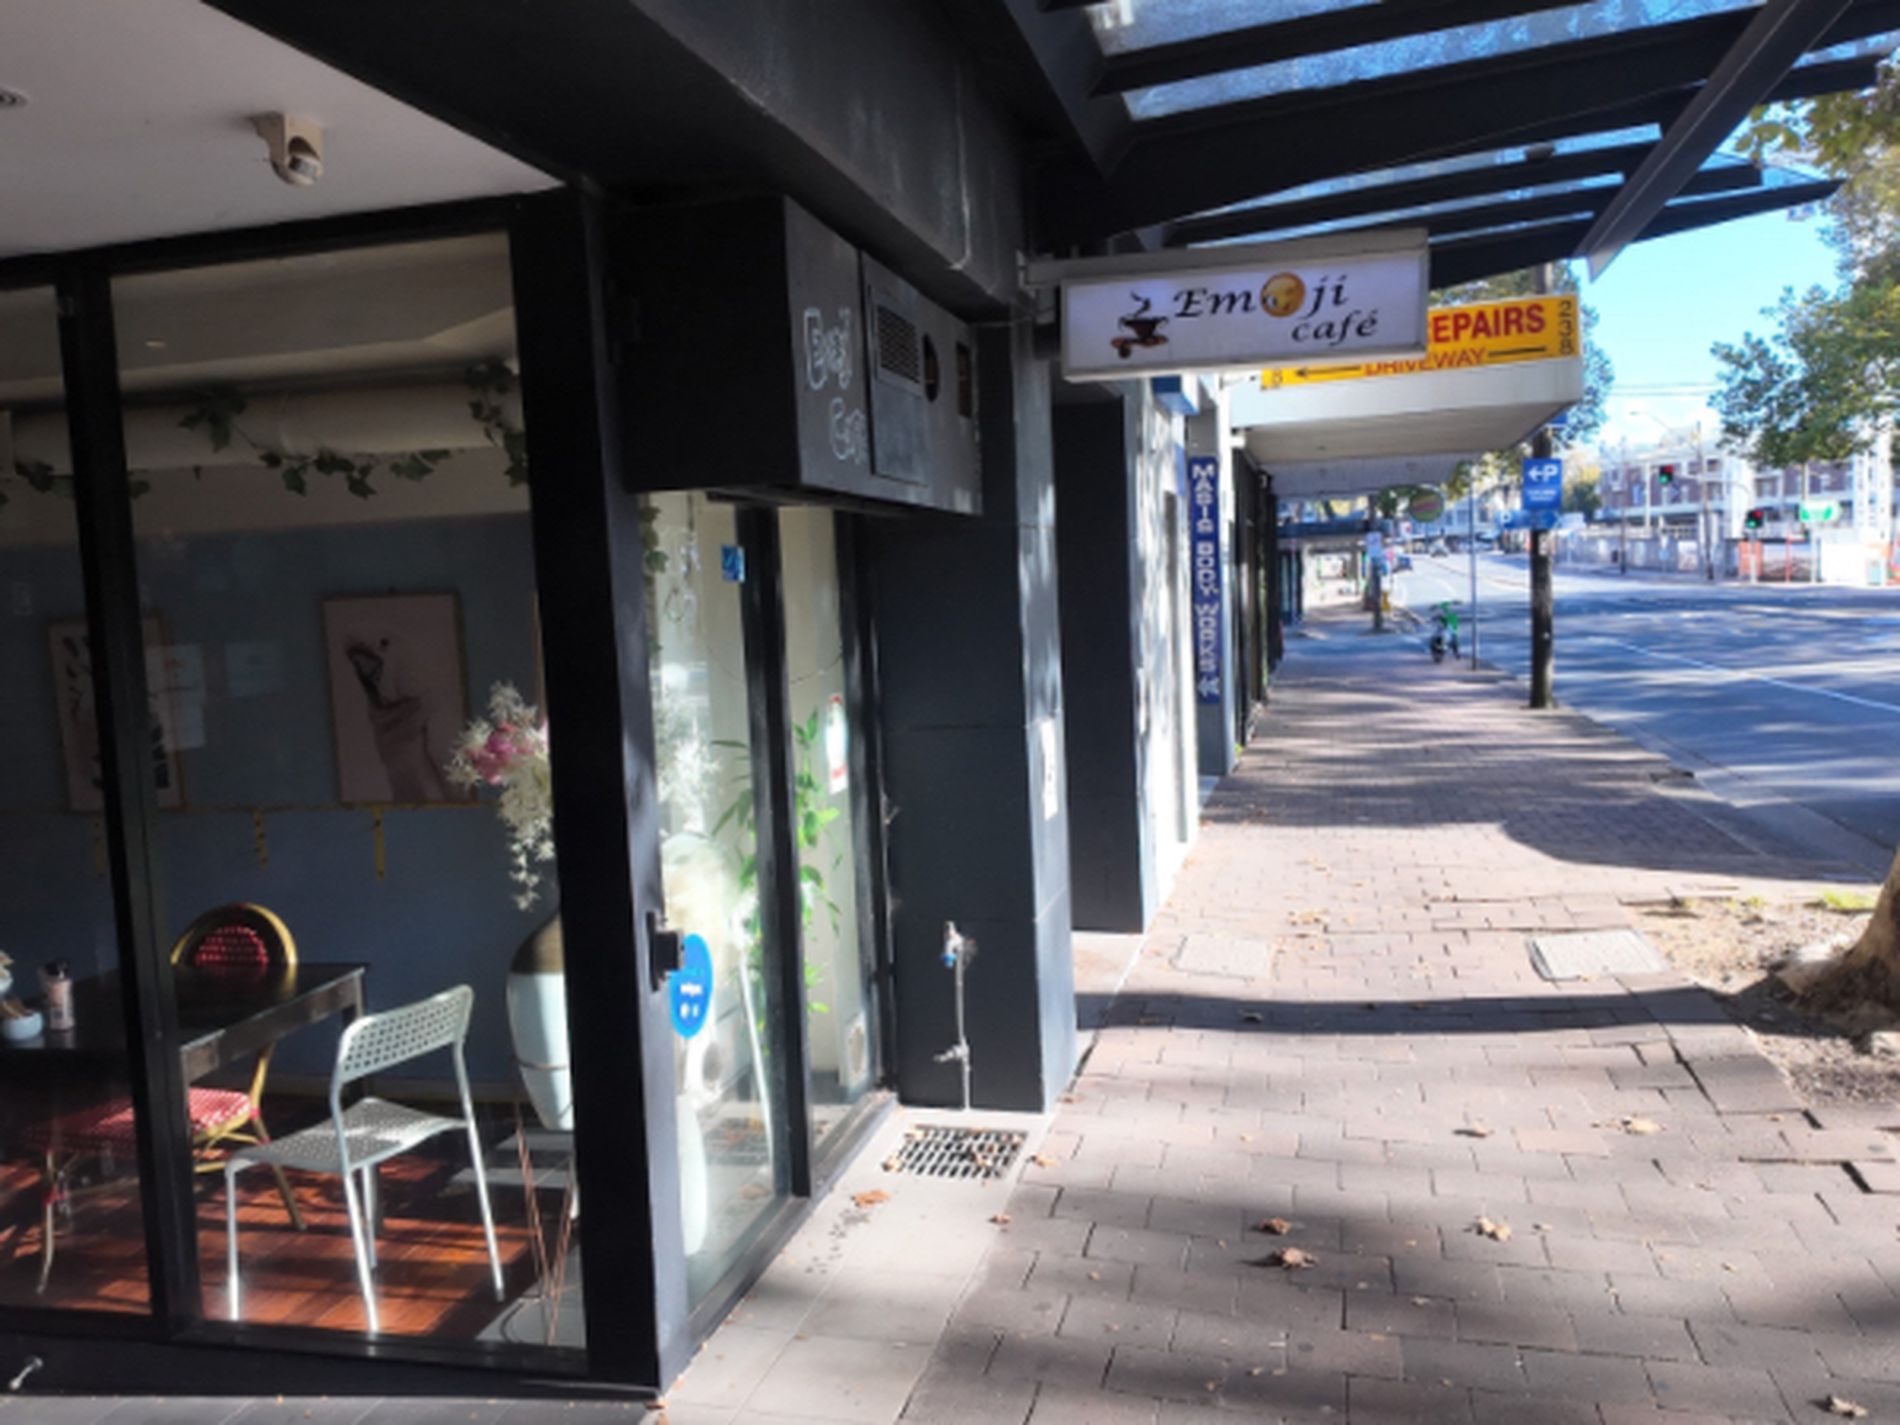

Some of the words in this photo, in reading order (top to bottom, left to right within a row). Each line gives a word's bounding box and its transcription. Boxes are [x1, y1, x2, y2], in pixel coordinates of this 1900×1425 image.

[1173, 272, 1348, 320] Emoji
[1291, 309, 1379, 346] café
[1431, 303, 1546, 344] EPAIRS
[1364, 347, 1488, 376] DRIVEWAY
[1195, 541, 1219, 597] BODY
[1194, 602, 1220, 673] WORKS
